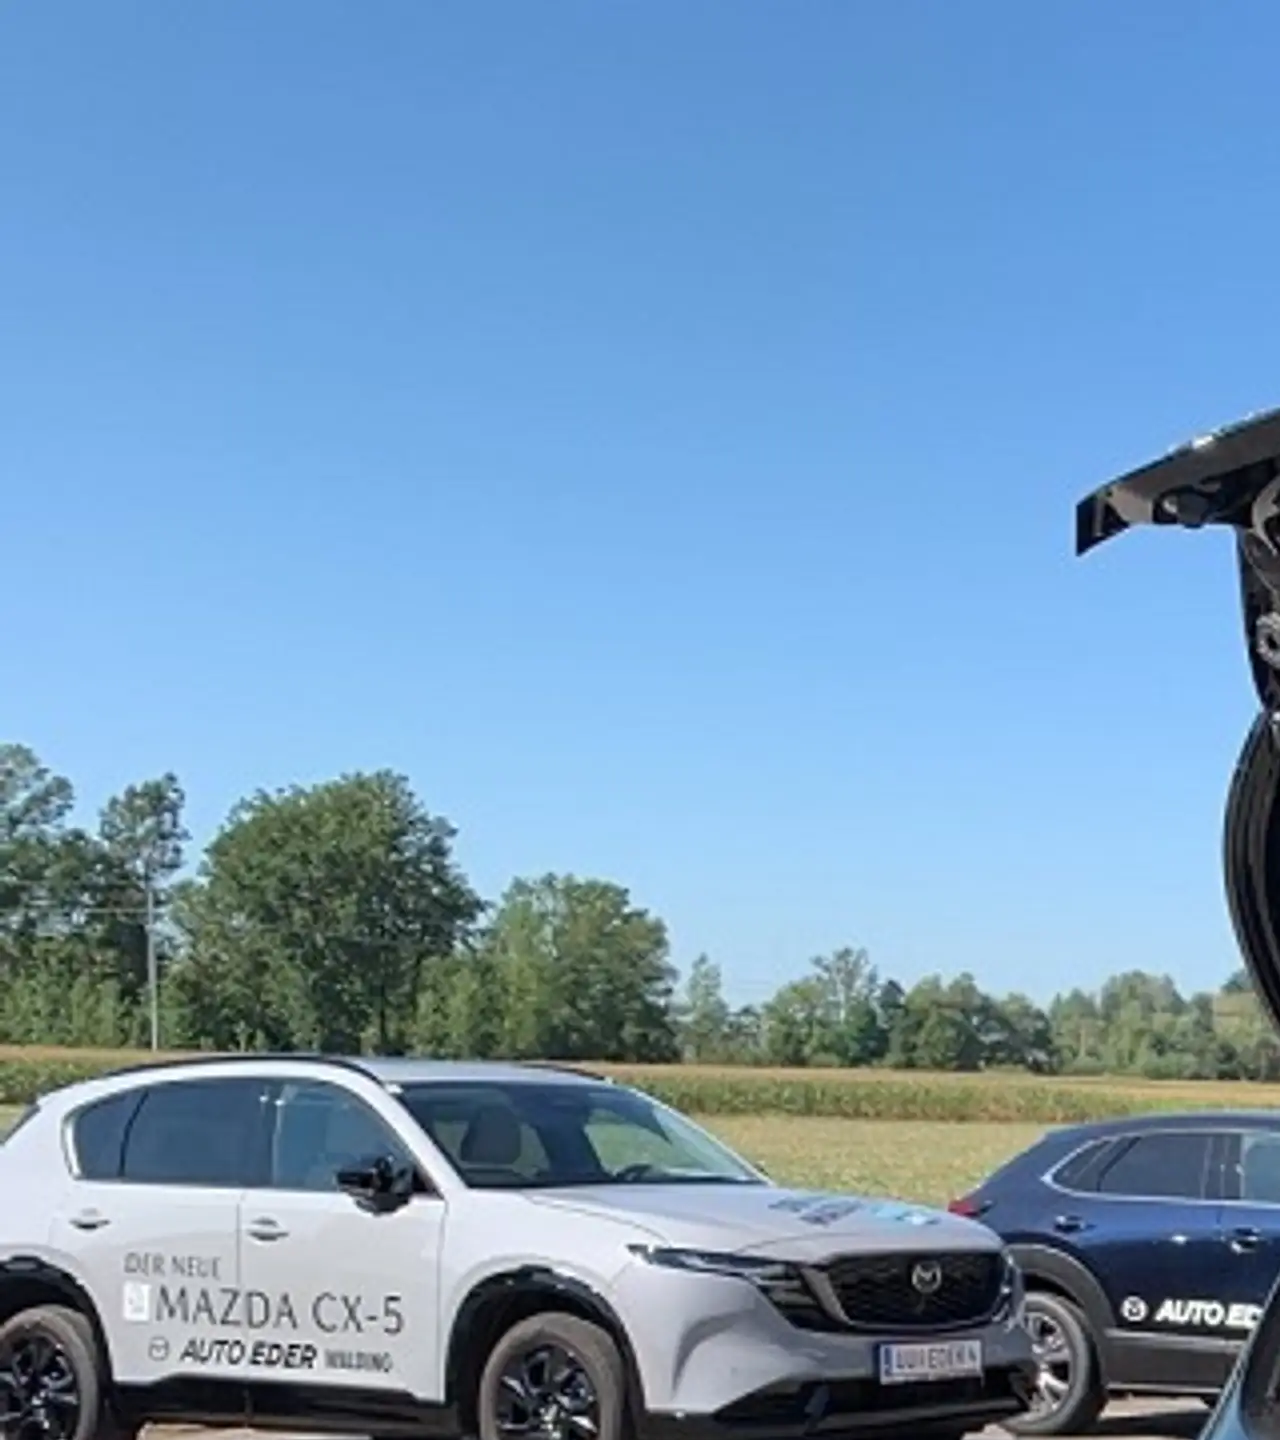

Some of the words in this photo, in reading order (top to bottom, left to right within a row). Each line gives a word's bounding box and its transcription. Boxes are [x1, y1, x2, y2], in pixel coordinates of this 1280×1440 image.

[124, 1253, 165, 1277] DER
[172, 1256, 221, 1280] NEUE
[155, 1285, 298, 1329] MAZDA
[311, 1291, 405, 1335] CX-5
[1155, 1298, 1225, 1326] AUTO
[179, 1338, 246, 1366] AUTO
[249, 1341, 317, 1369] EDER
